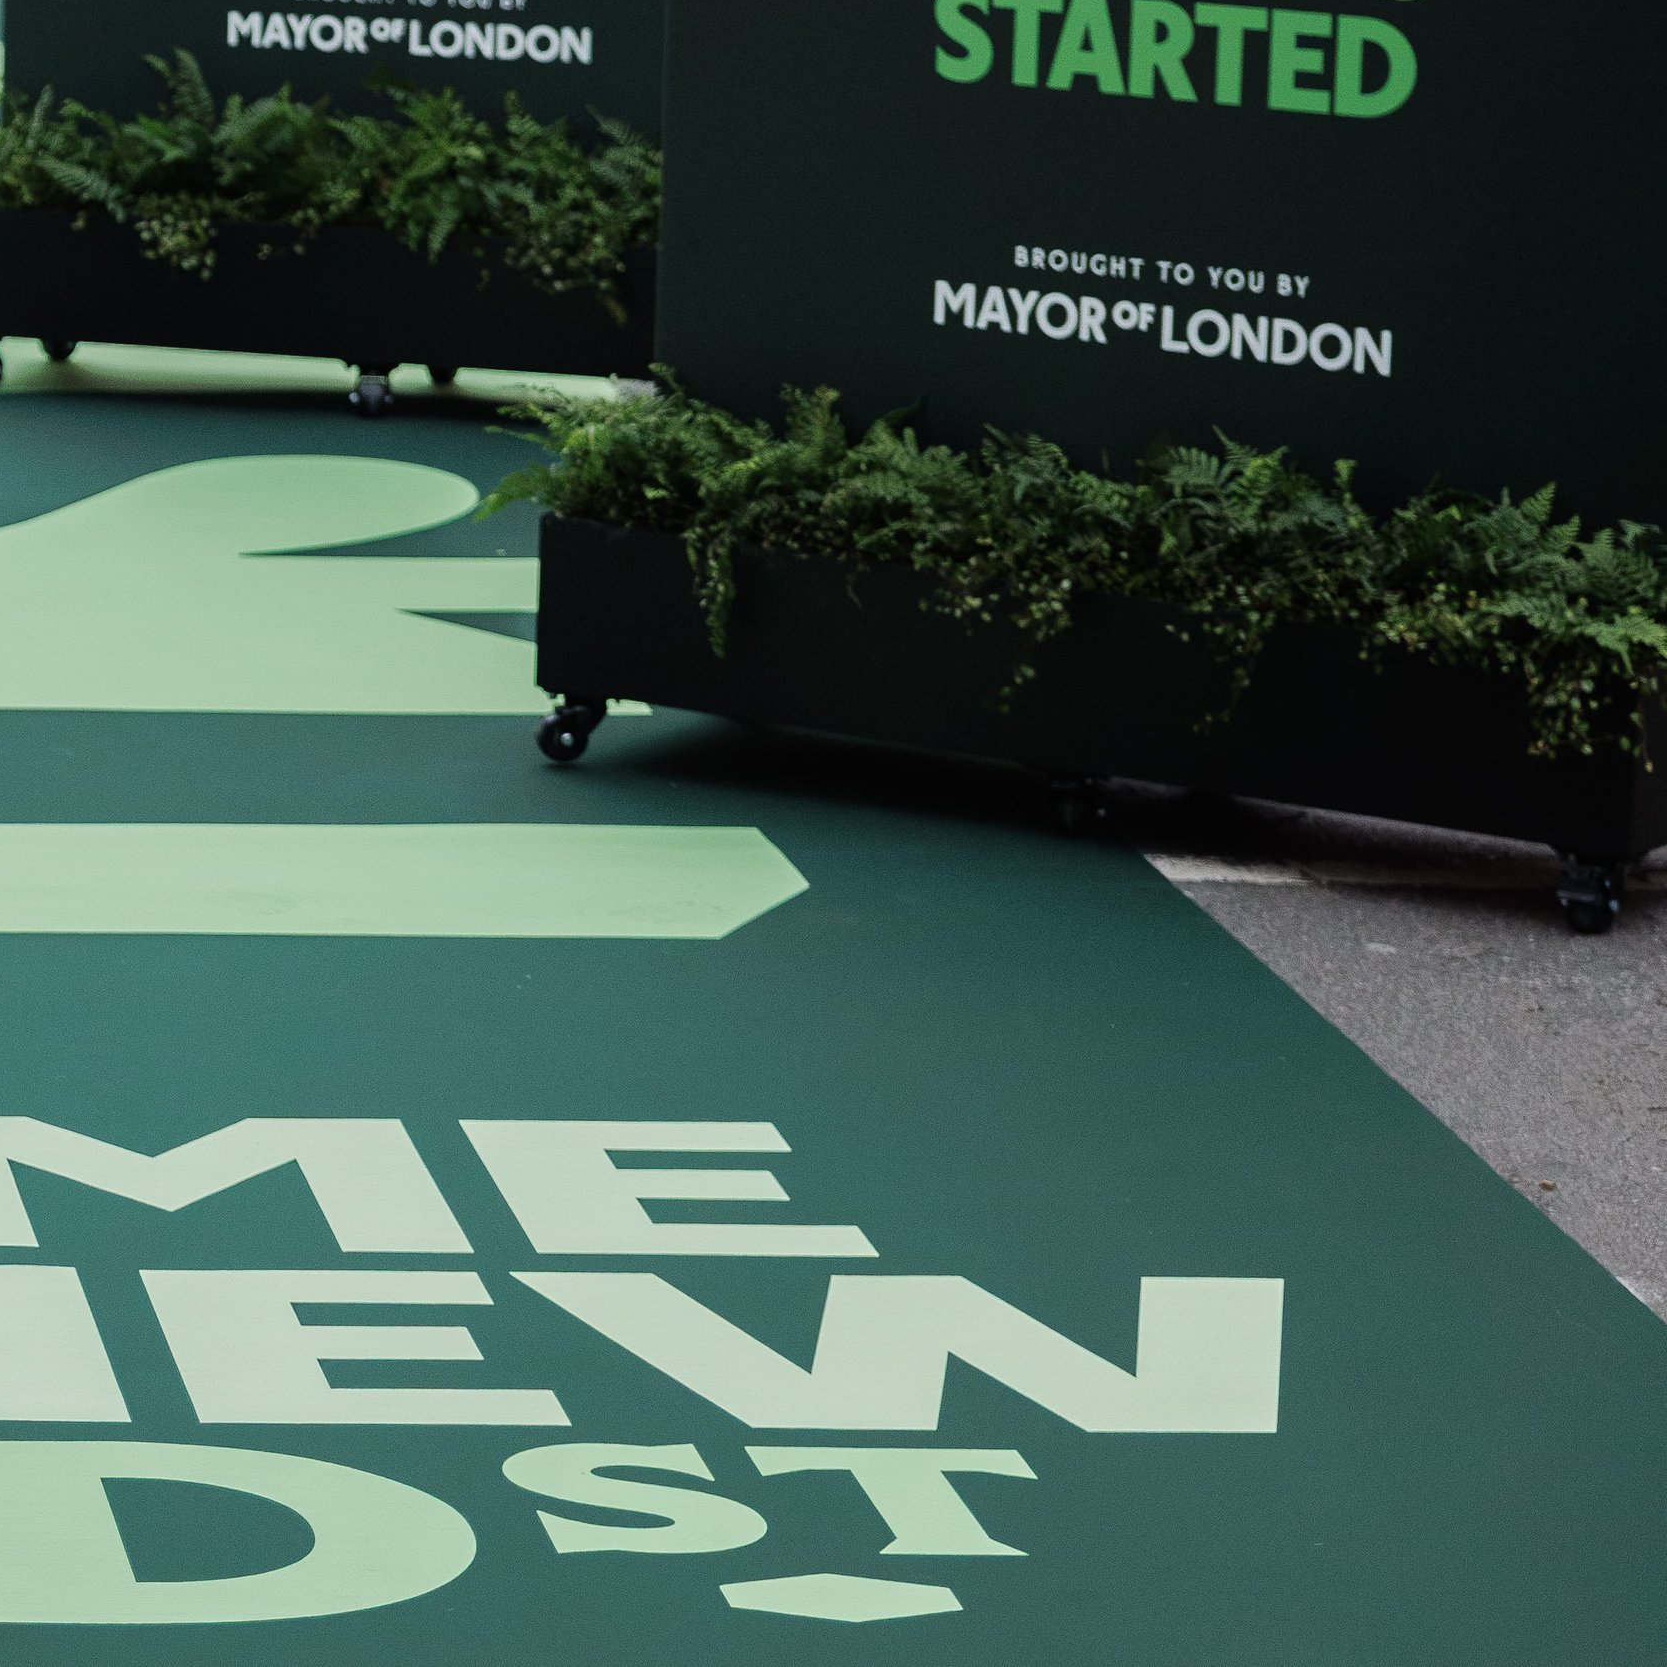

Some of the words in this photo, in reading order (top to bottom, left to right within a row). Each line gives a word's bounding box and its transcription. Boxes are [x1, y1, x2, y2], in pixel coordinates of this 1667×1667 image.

[1014, 245, 1144, 279] BROUGHT
[1156, 260, 1195, 285] TO
[1208, 266, 1264, 293] YOU
[1277, 274, 1310, 298] BY
